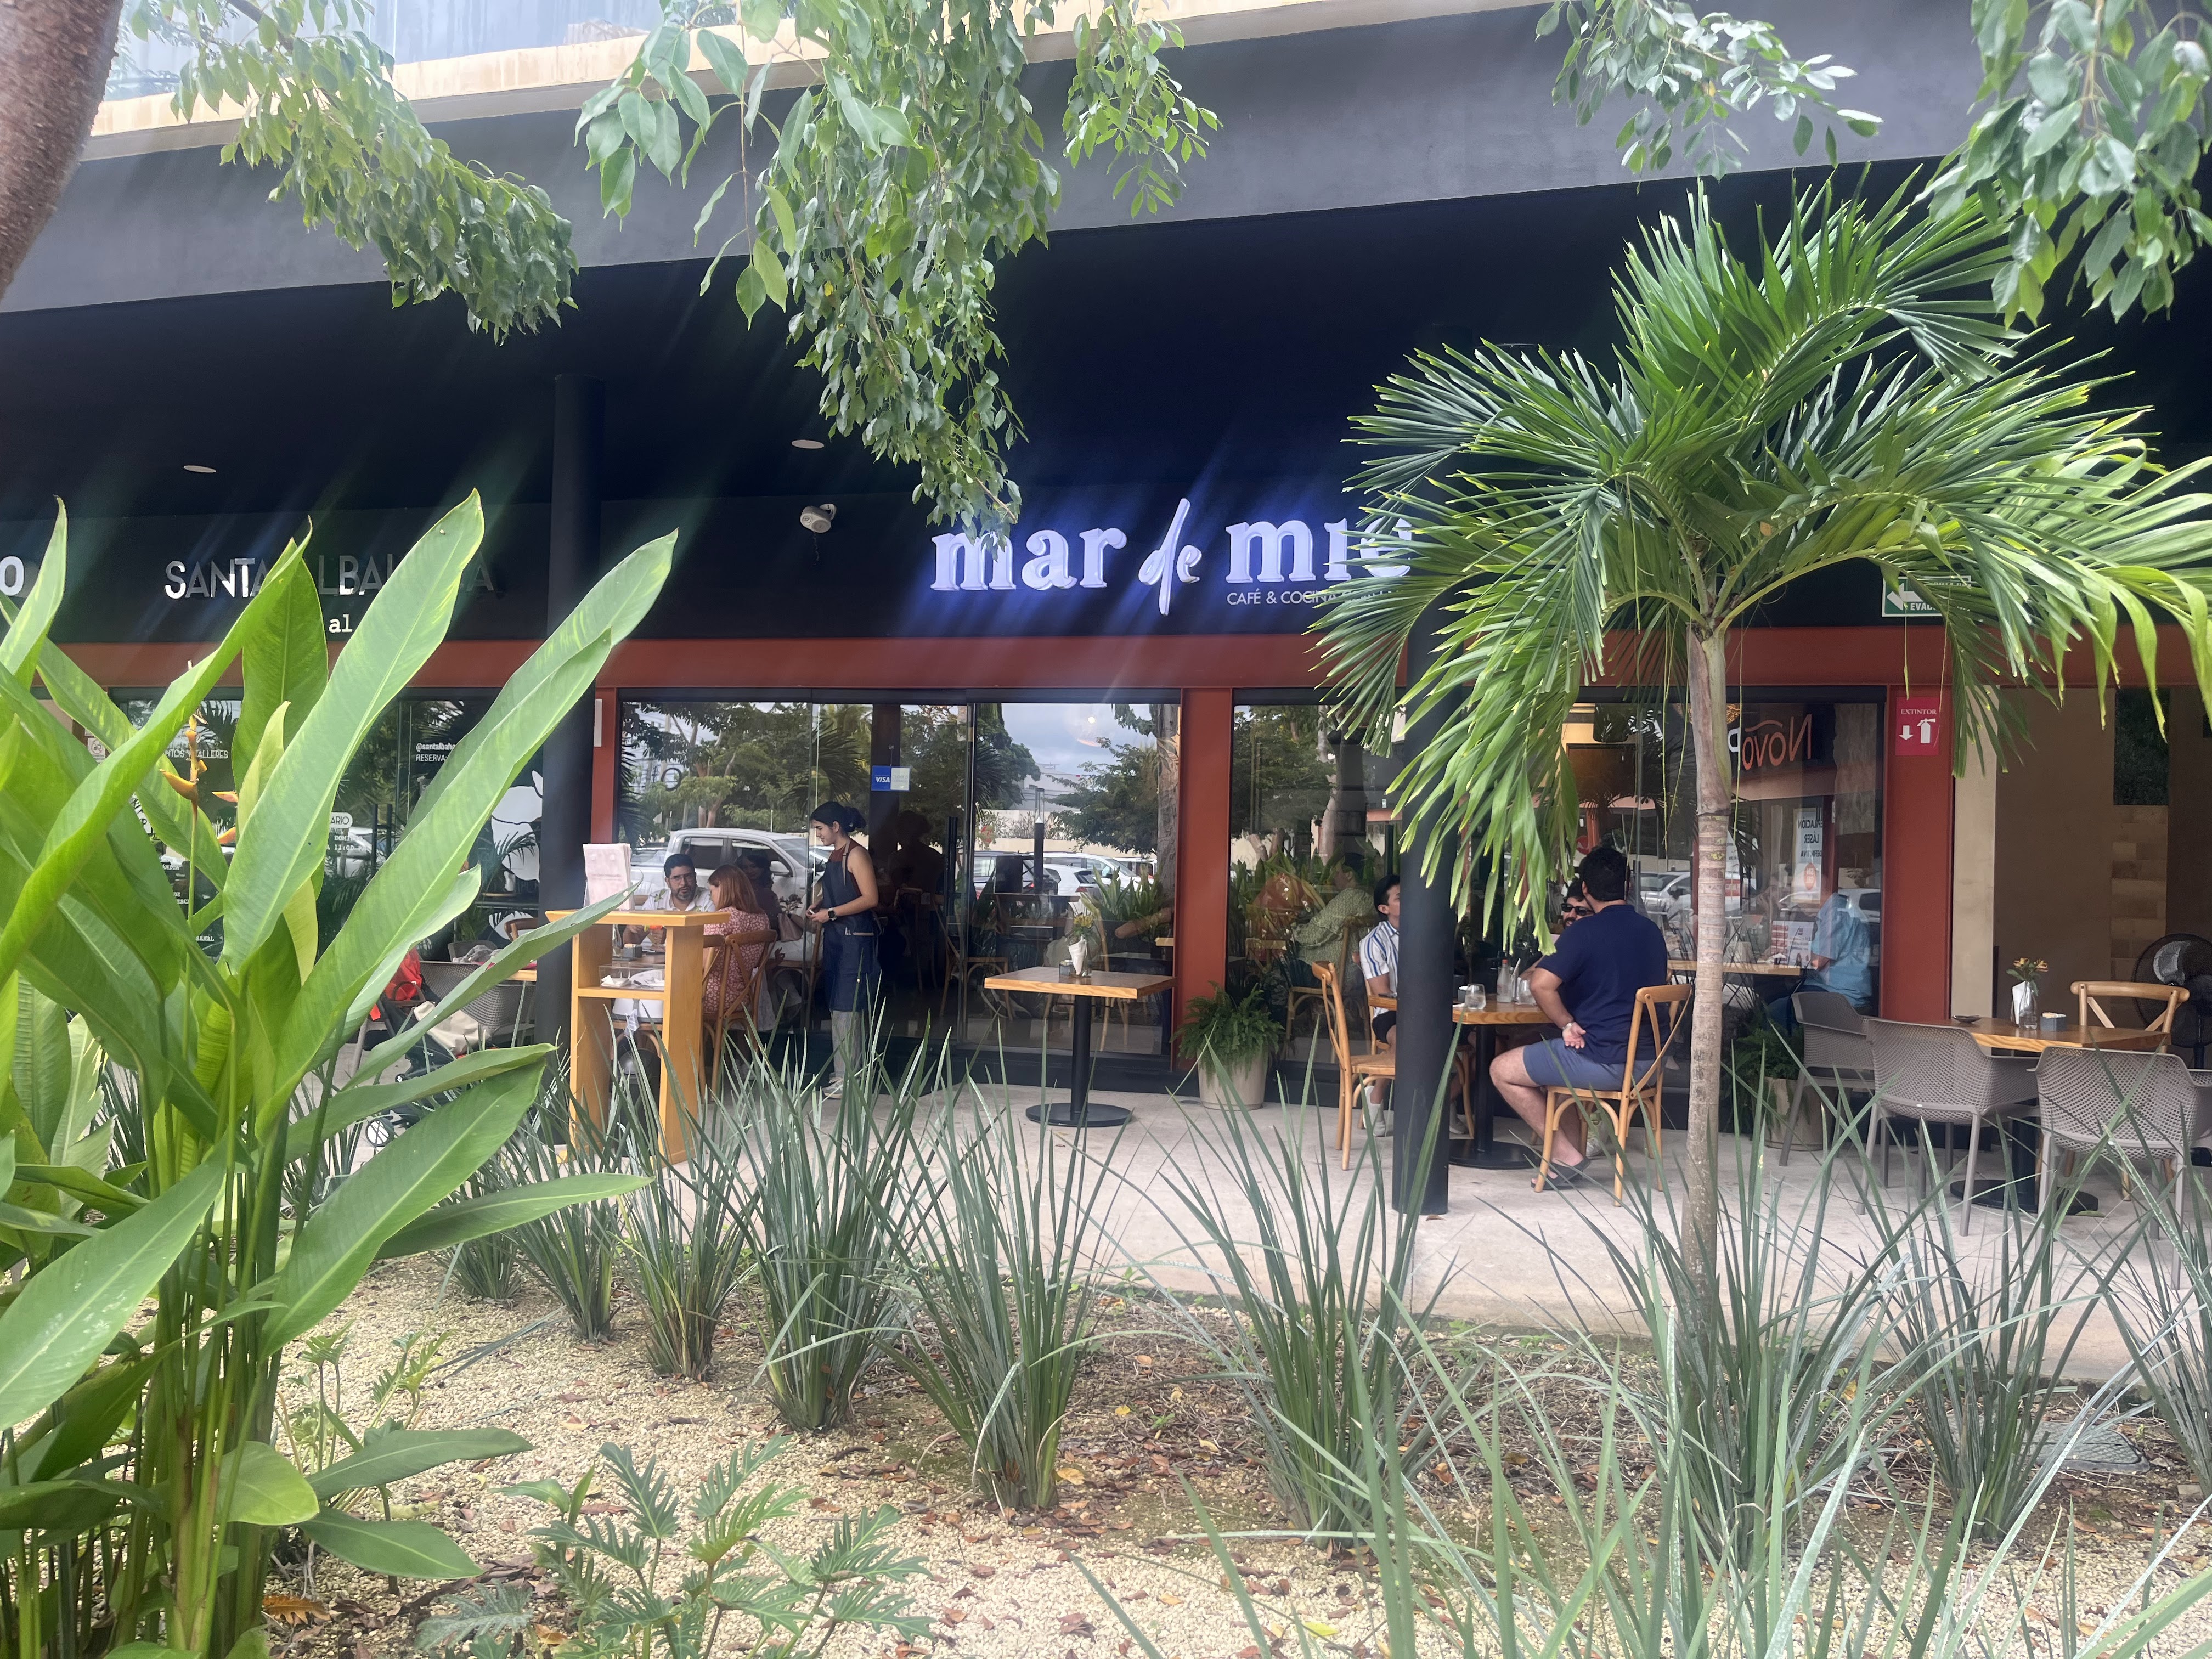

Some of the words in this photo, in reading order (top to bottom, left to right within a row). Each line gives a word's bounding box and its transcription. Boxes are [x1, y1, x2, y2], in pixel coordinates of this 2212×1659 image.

[930, 528, 1127, 591] mar
[1138, 498, 1202, 616] de
[1227, 588, 1261, 605] CAFÉ
[1266, 591, 1277, 605] &
[329, 614, 353, 633] al
[416, 742, 456, 752] @santalbaha
[330, 816, 349, 825] ARIO
